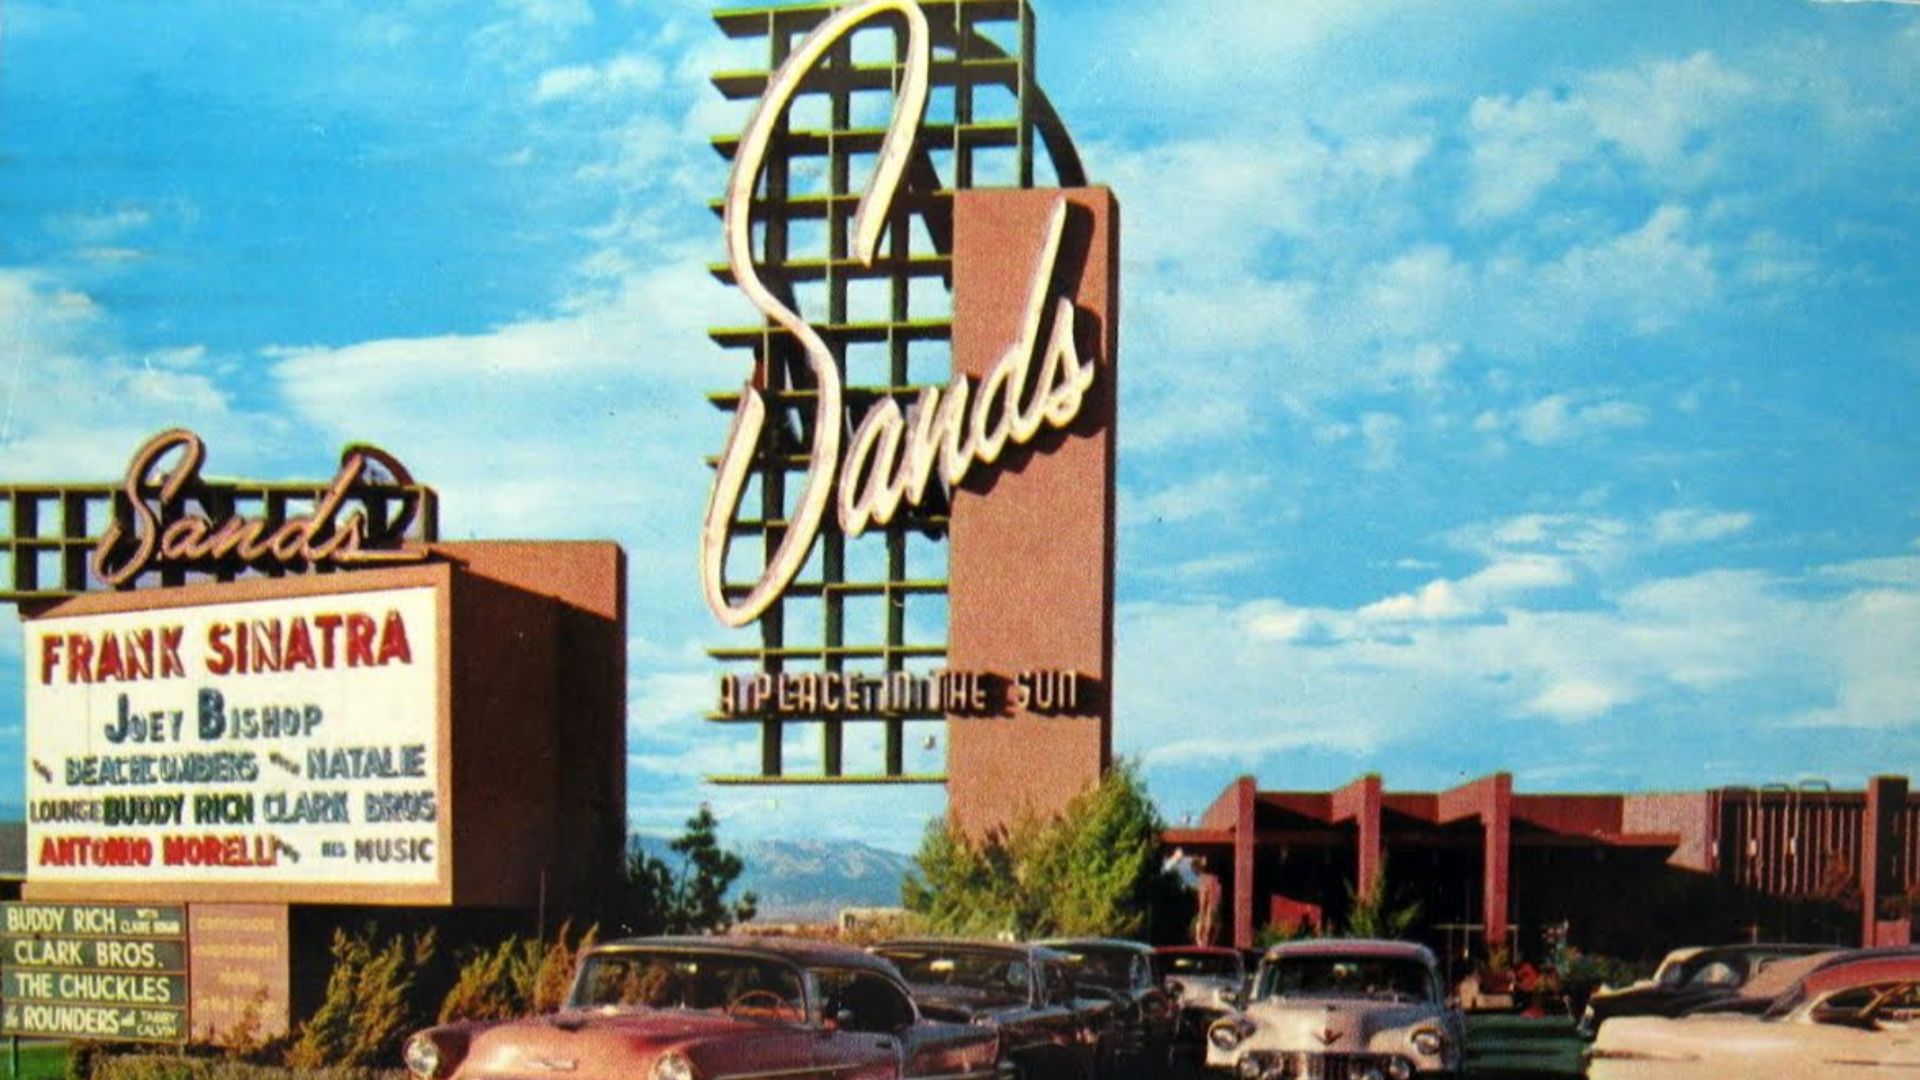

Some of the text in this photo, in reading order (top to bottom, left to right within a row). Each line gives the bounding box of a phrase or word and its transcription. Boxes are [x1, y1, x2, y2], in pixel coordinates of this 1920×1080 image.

[704, 0, 1095, 627] Sands
[93, 428, 366, 584] Sands
[41, 610, 411, 684] FRANK SINATRA
[754, 672, 860, 711] PLACE
[1014, 670, 1076, 709] SUN
[104, 688, 323, 743] JOEY BISHOP
[30, 800, 102, 823] LOUNGE
[103, 793, 184, 826] BUDDY
[194, 791, 254, 825] RICH
[263, 790, 350, 824] CLARK
[39, 836, 153, 867] ANTONIO
[354, 837, 434, 863] MUSIC
[7, 907, 116, 934] BUDDY RICH
[14, 940, 83, 965] CLARK
[96, 942, 164, 968] BROS.
[15, 973, 171, 1003] THE CHUCKLES
[24, 1006, 119, 1034] ROUNDERS
